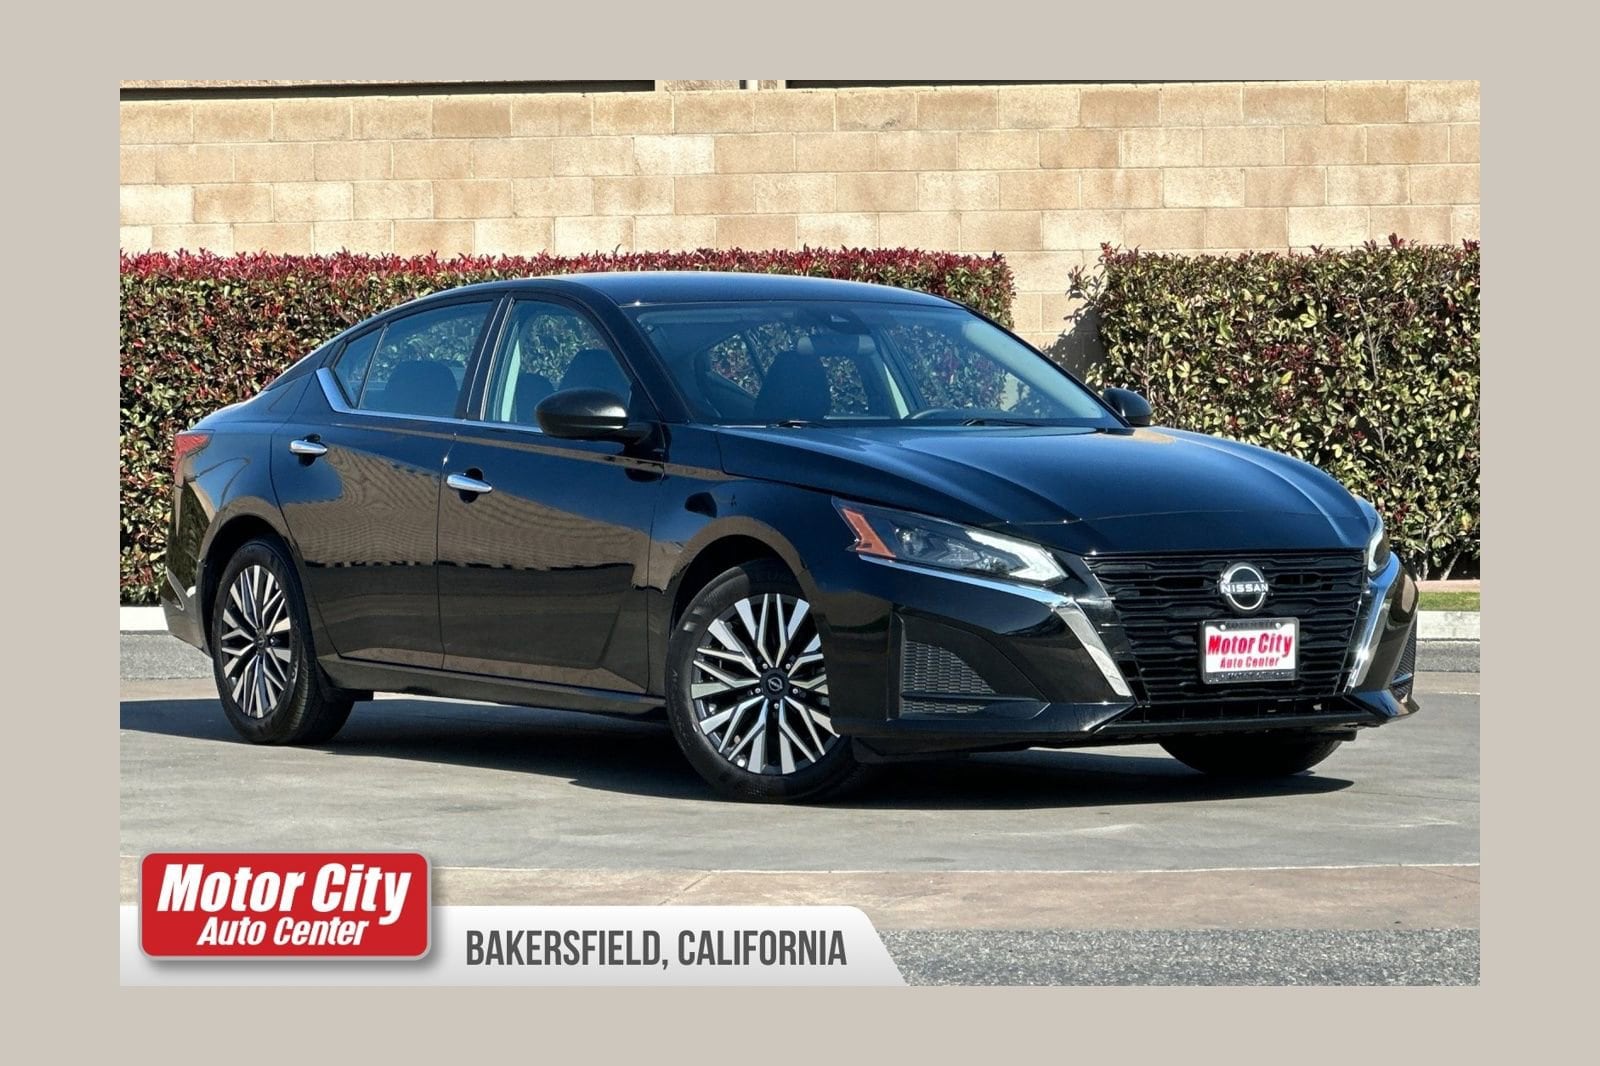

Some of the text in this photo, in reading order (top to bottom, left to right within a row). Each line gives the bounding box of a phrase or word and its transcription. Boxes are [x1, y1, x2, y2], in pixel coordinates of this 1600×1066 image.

[1220, 583, 1269, 594] NISSAN
[1207, 633, 1293, 657] Motor City
[1220, 656, 1280, 669] Auto Center
